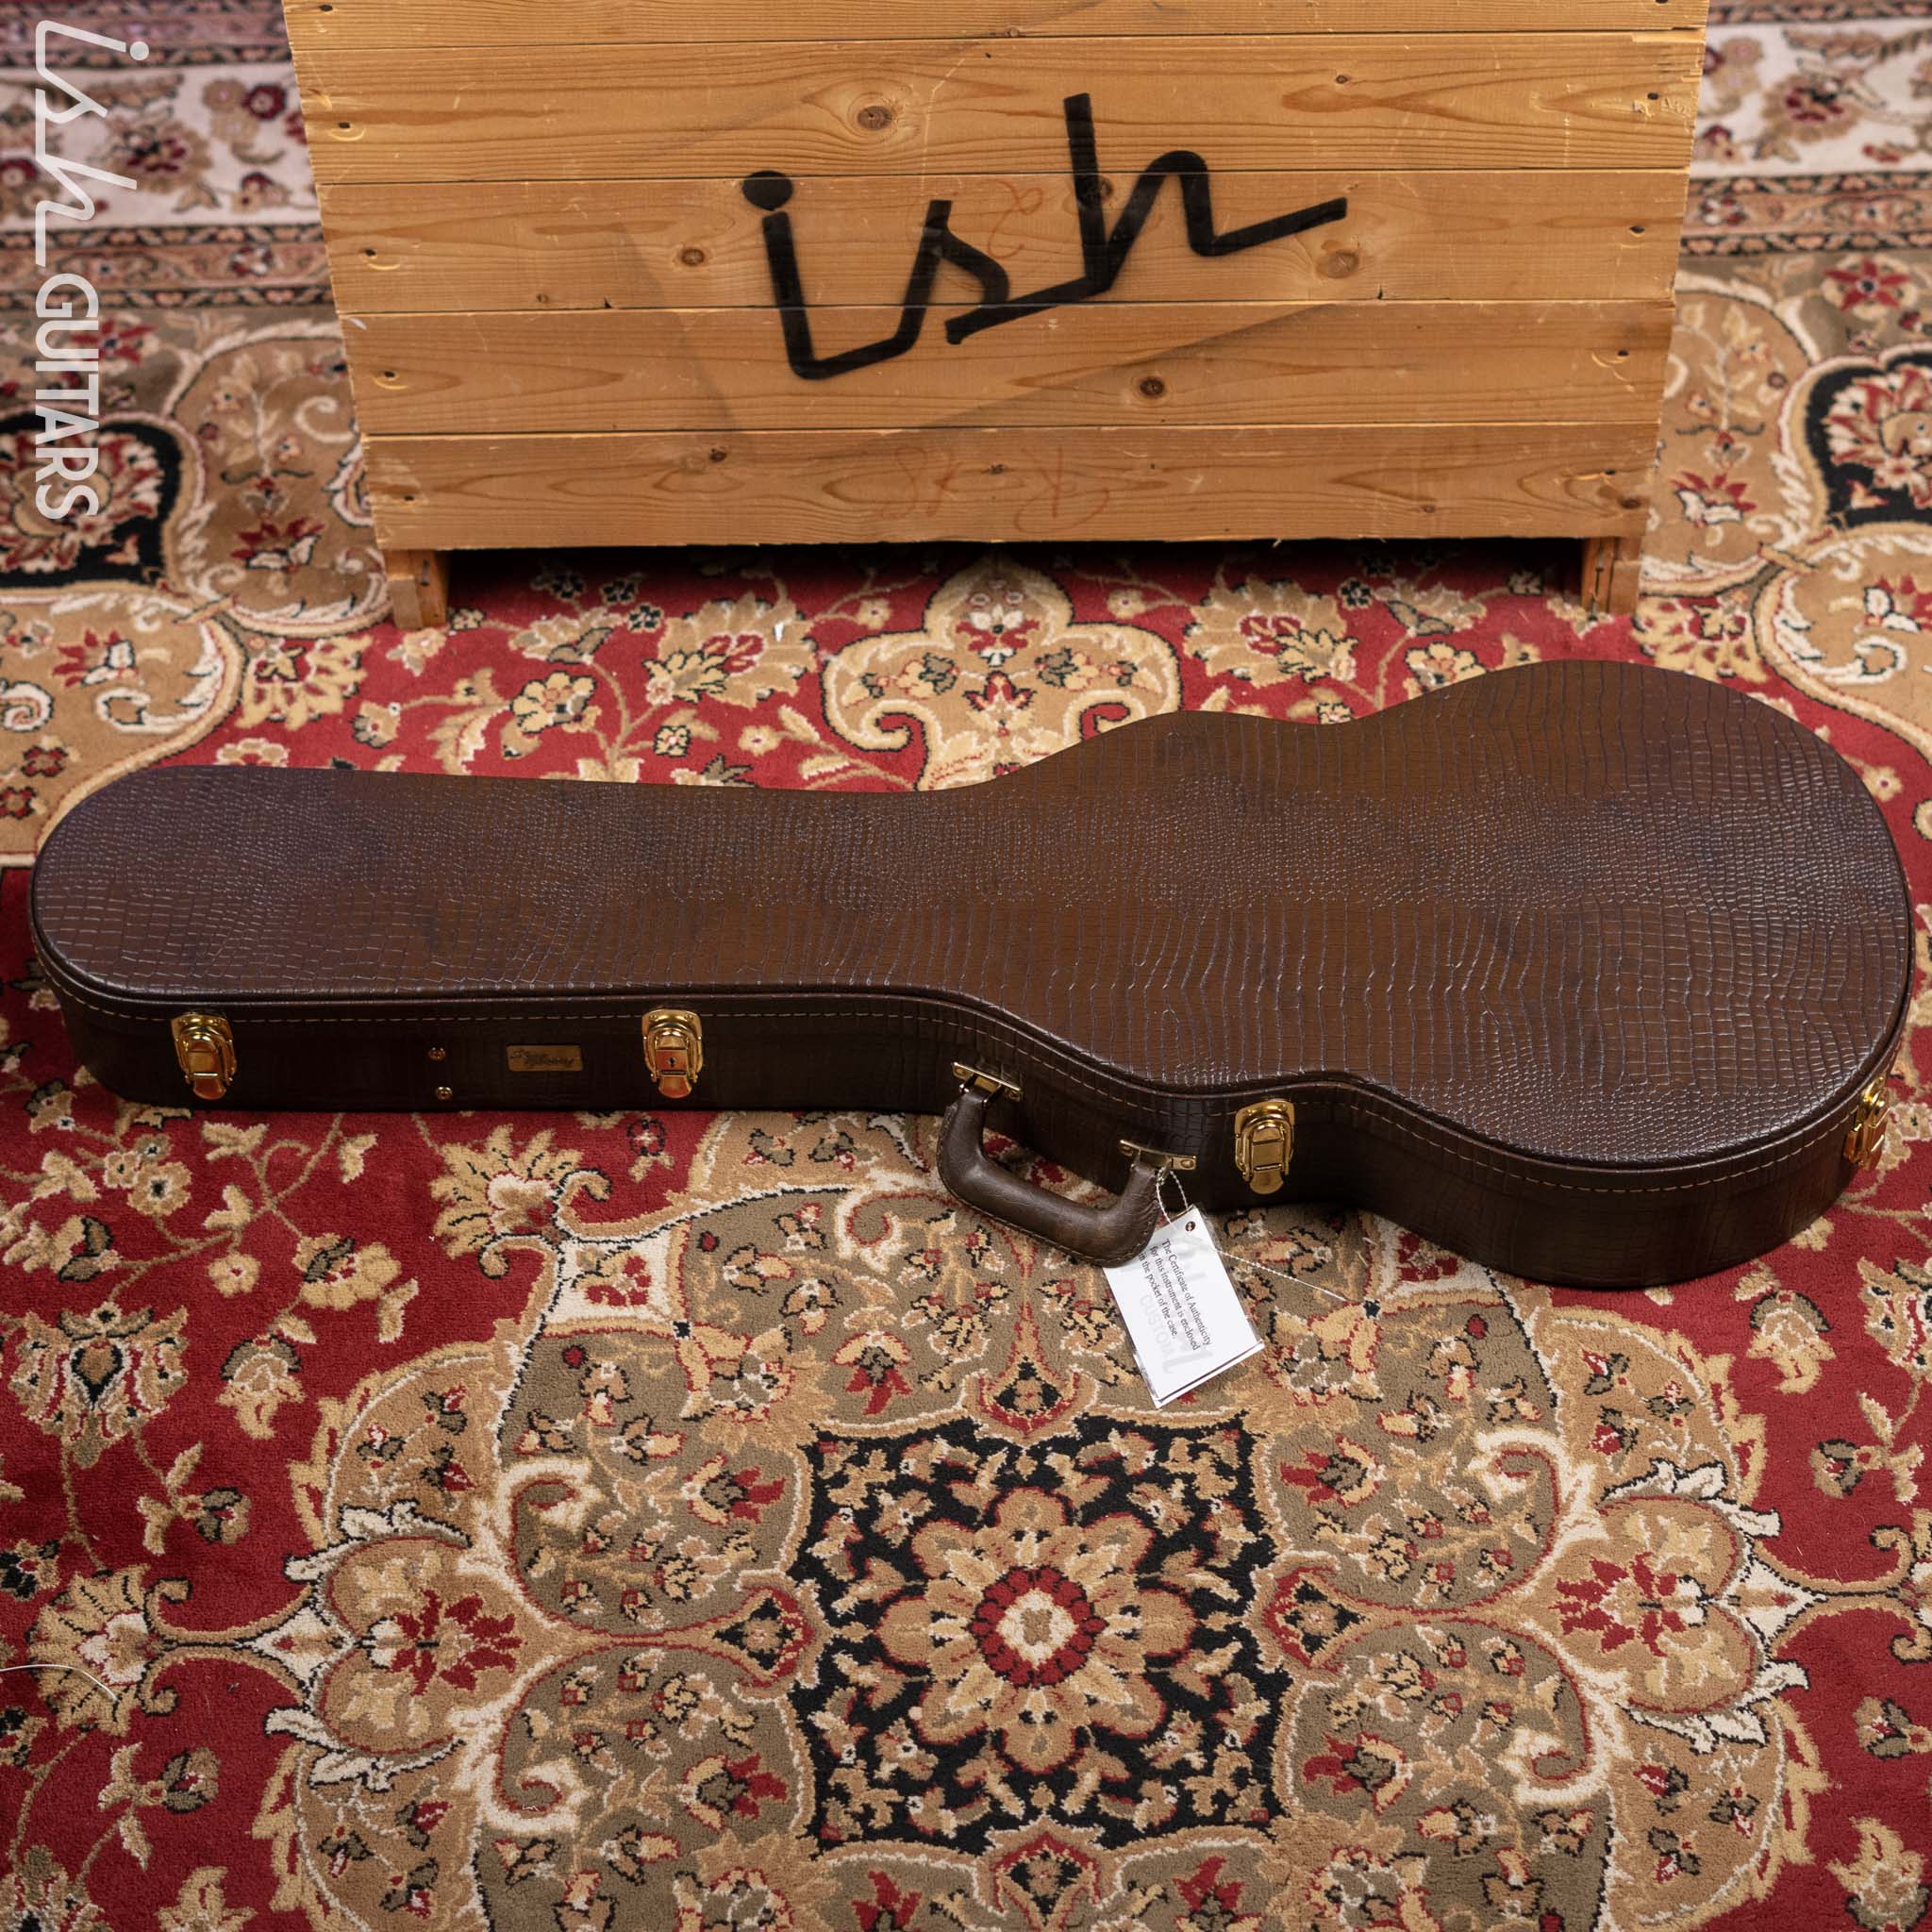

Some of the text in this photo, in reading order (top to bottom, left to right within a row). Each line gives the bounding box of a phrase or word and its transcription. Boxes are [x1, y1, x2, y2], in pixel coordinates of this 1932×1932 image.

[742, 92, 1347, 380] ish
[1141, 1261, 1151, 1274] the
[1144, 1274, 1162, 1298] pocket
[1149, 1245, 1158, 1257] for
[1155, 1257, 1165, 1273] this
[1160, 1271, 1182, 1310] instrument
[1178, 1319, 1202, 1351] enclosed
[1159, 1239, 1172, 1255] The
[1166, 1254, 1188, 1292] Certificate
[1187, 1302, 1212, 1348] Authenticity
[1158, 1298, 1168, 1307] of
[1161, 1307, 1173, 1320] the
